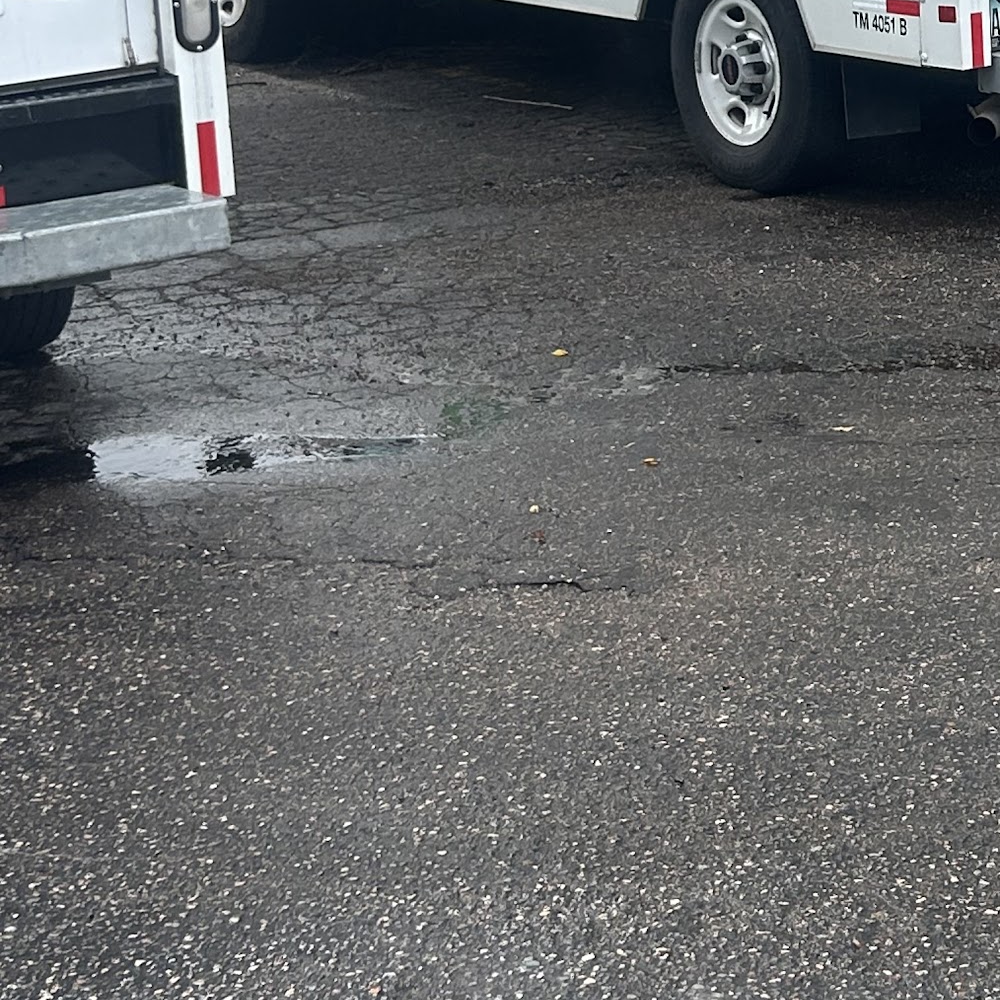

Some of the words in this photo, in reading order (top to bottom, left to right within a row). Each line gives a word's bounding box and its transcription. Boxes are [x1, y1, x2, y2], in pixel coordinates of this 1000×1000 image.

[853, 11, 869, 30] TM
[872, 14, 895, 34] 4051
[900, 18, 907, 36] B
